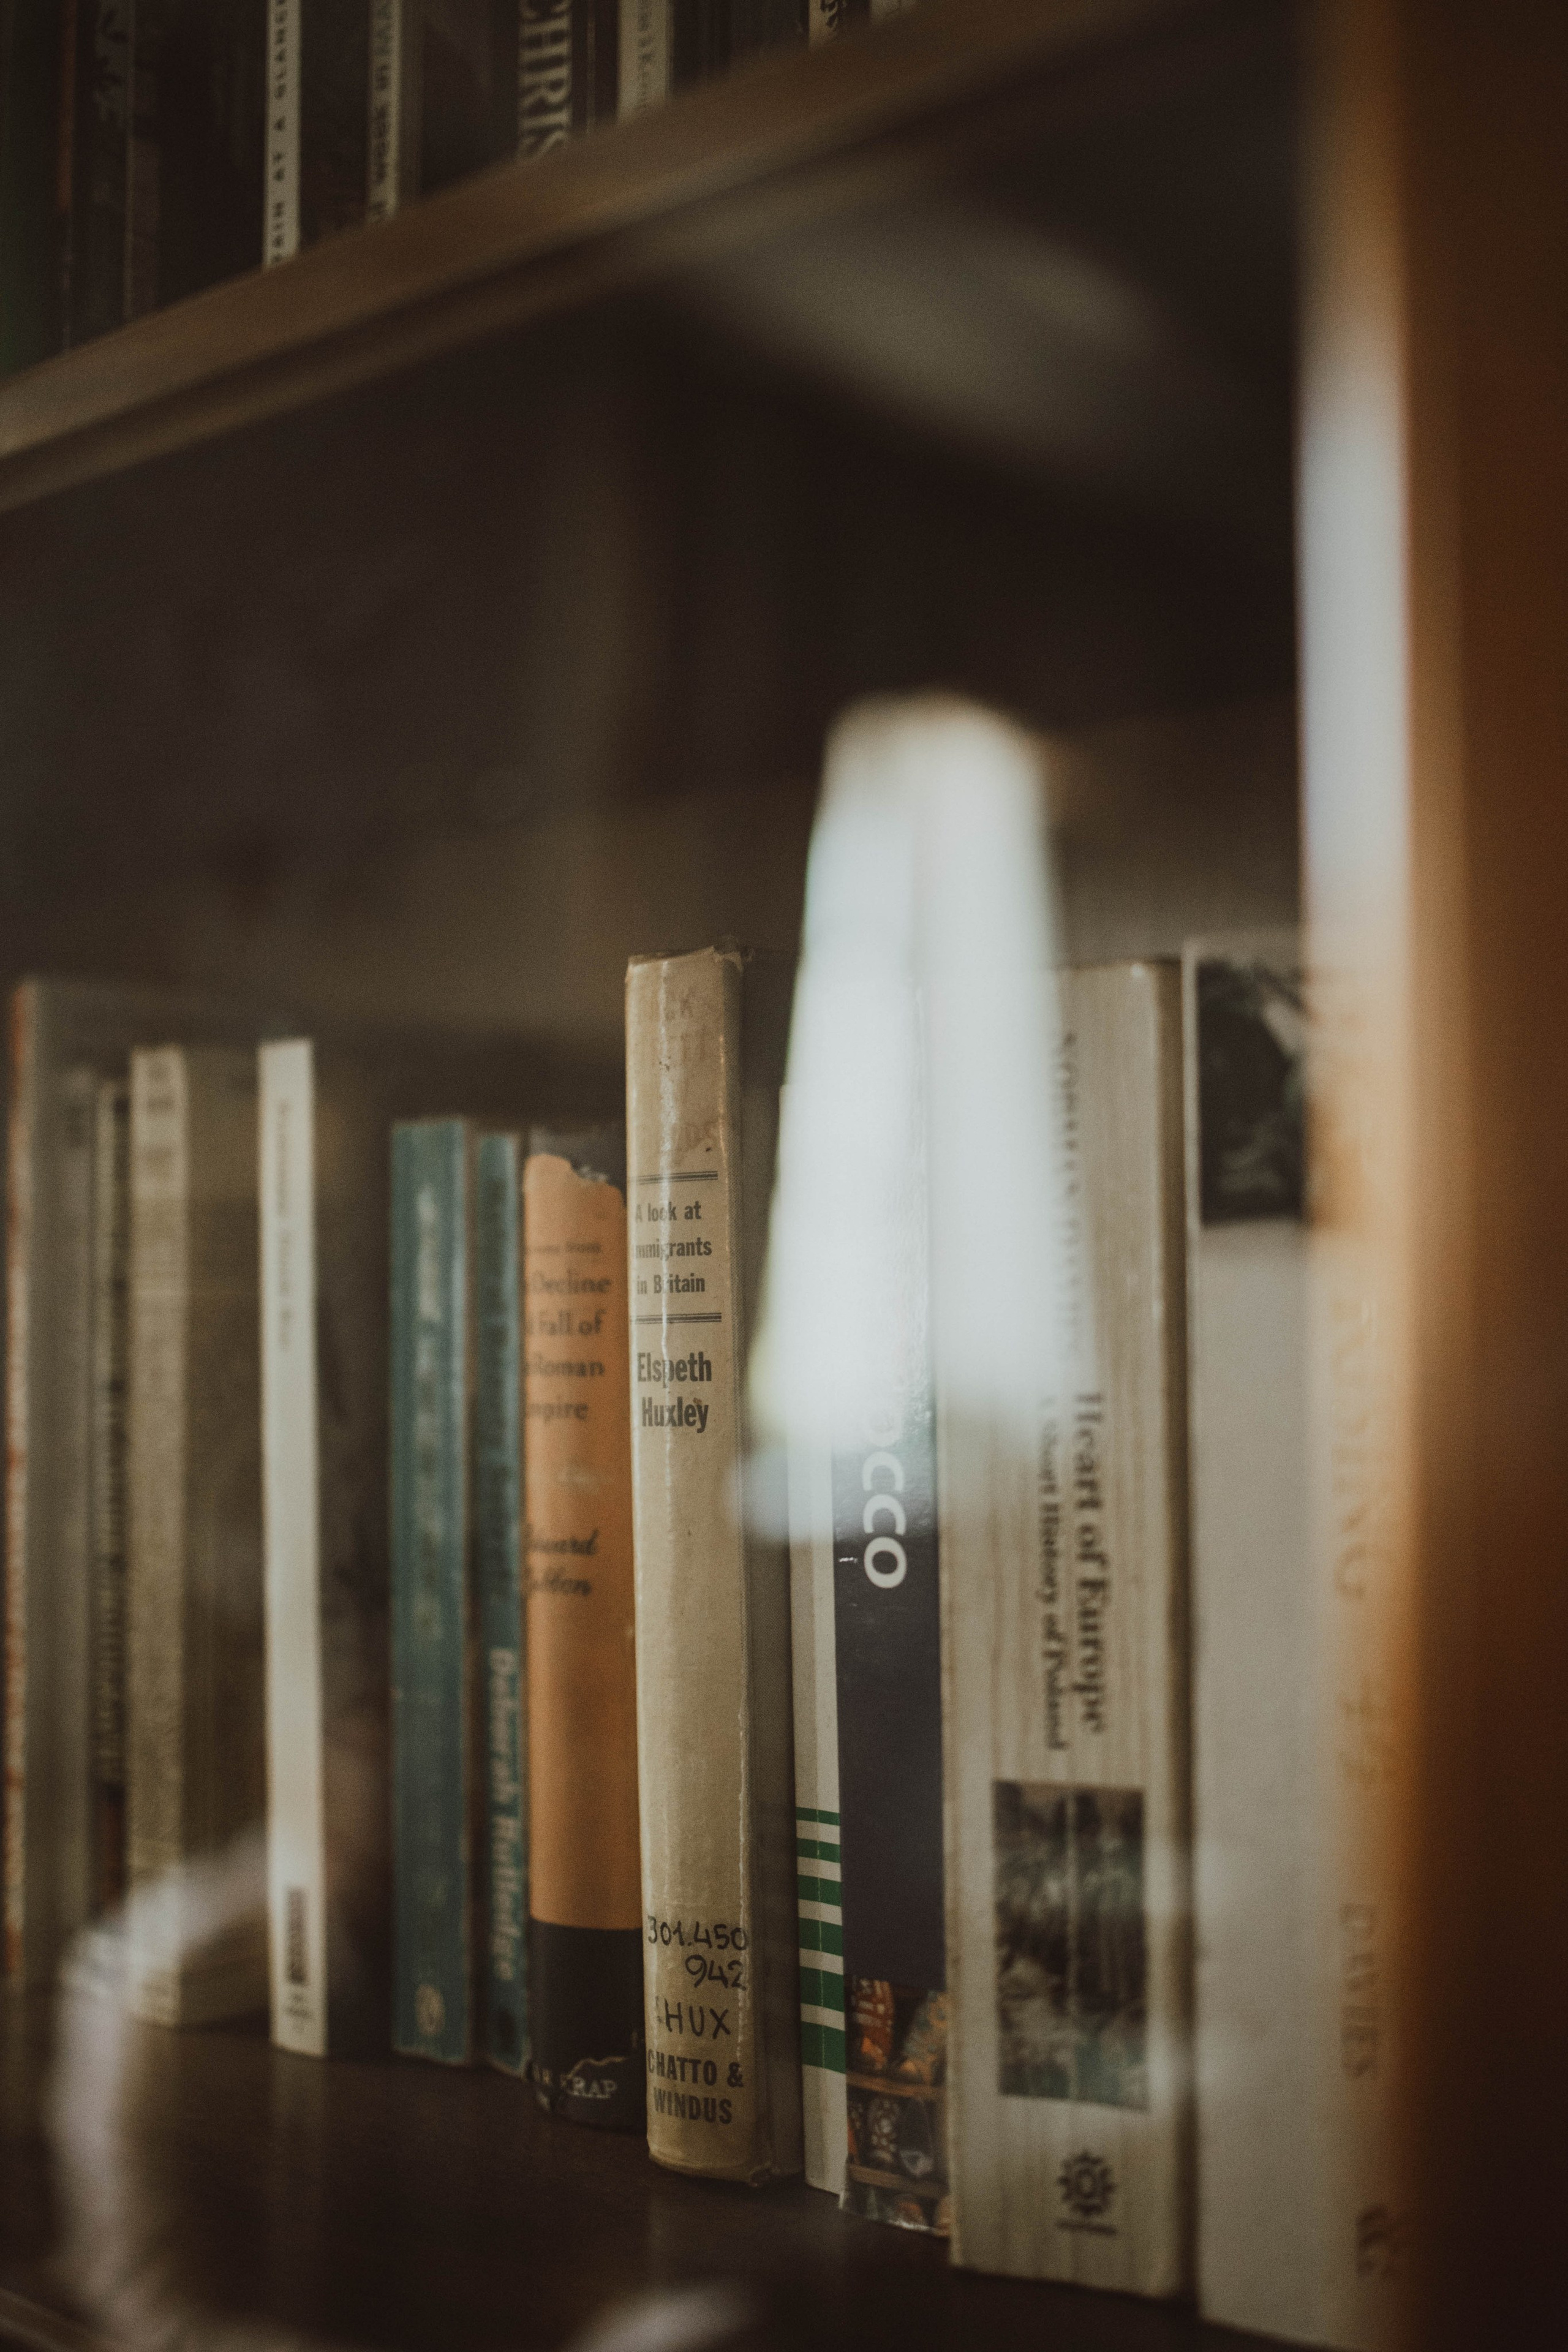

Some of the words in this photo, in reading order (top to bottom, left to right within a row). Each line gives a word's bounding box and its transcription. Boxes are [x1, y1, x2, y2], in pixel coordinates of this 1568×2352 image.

[635, 1204, 643, 1223] A
[648, 1201, 677, 1222] look
[684, 1200, 702, 1220] at
[635, 1237, 712, 1262] mmigrants
[636, 1276, 647, 1294] in
[578, 1307, 607, 1336] of
[638, 1351, 712, 1388] Elspeth
[641, 1396, 709, 1433] Huxley
[1076, 1523, 1109, 1569] of
[1071, 1578, 1110, 1735] Europe
[647, 1915, 748, 1951] 301.450
[685, 1954, 747, 1991] 942
[663, 1996, 731, 2040] HUX
[647, 2048, 718, 2086] CHATTO
[727, 2061, 744, 2088] &
[653, 2086, 733, 2124] WINDUS
